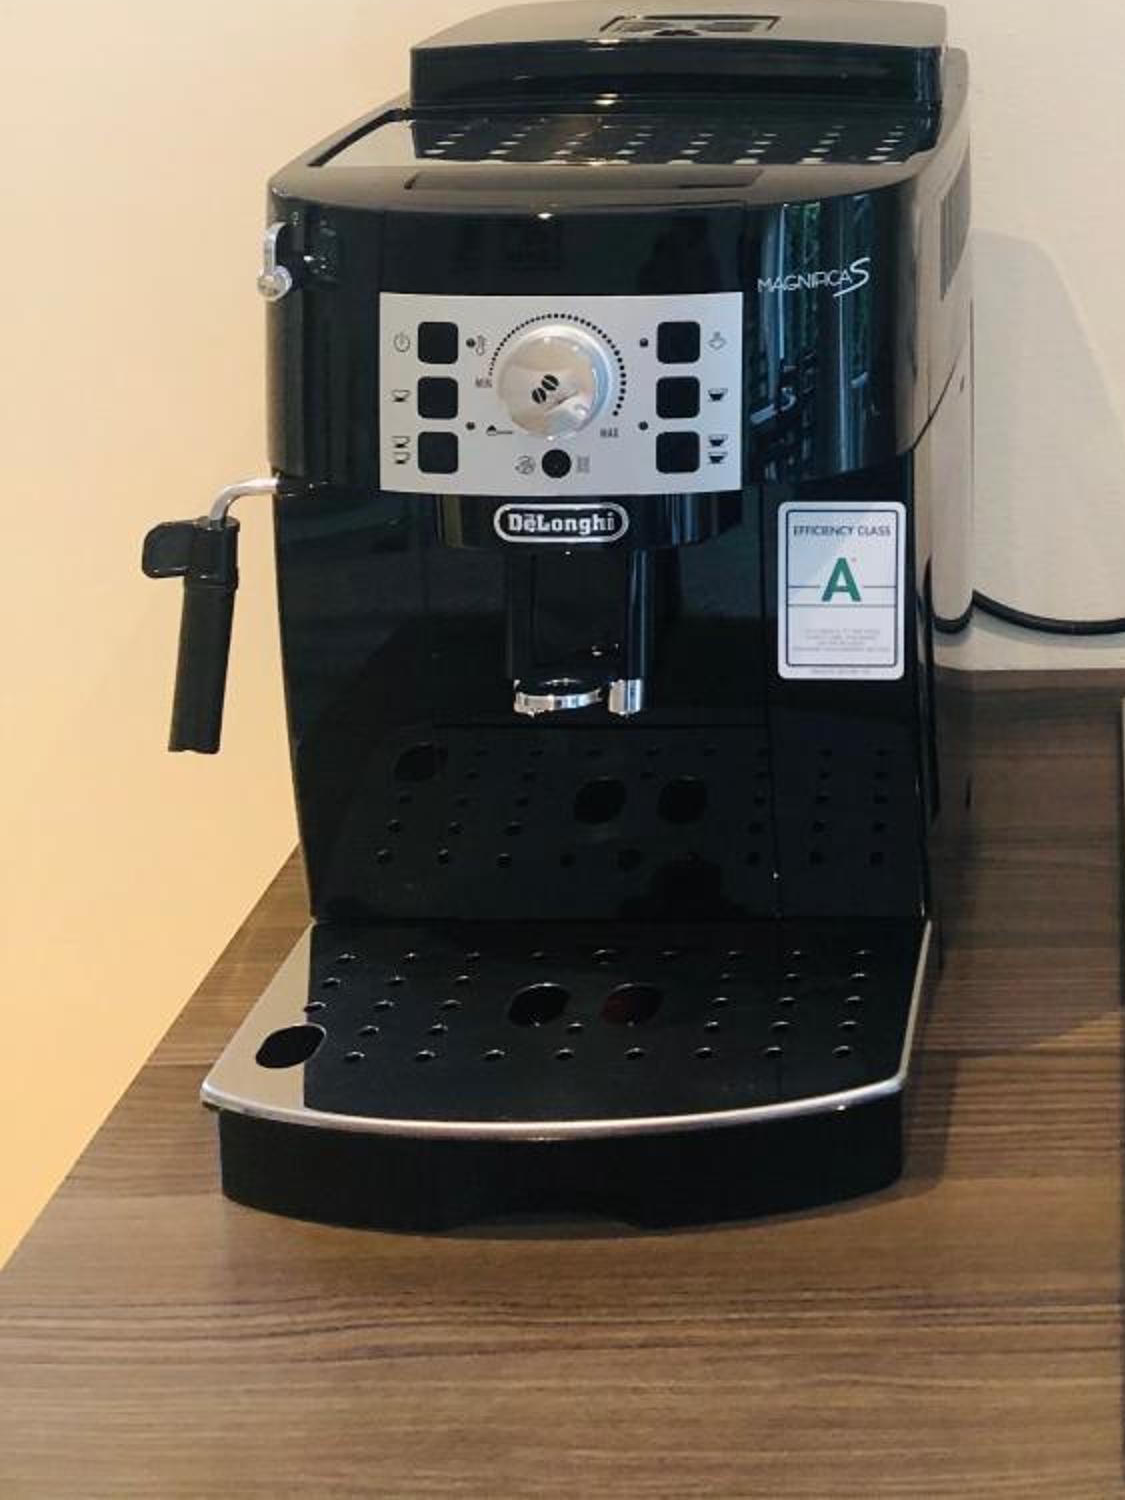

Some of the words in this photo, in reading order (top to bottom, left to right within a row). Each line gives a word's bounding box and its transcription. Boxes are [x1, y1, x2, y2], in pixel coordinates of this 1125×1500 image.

[793, 525, 853, 537] EFFICIENCY
[857, 525, 891, 537] CLASS
[821, 557, 861, 602] A
